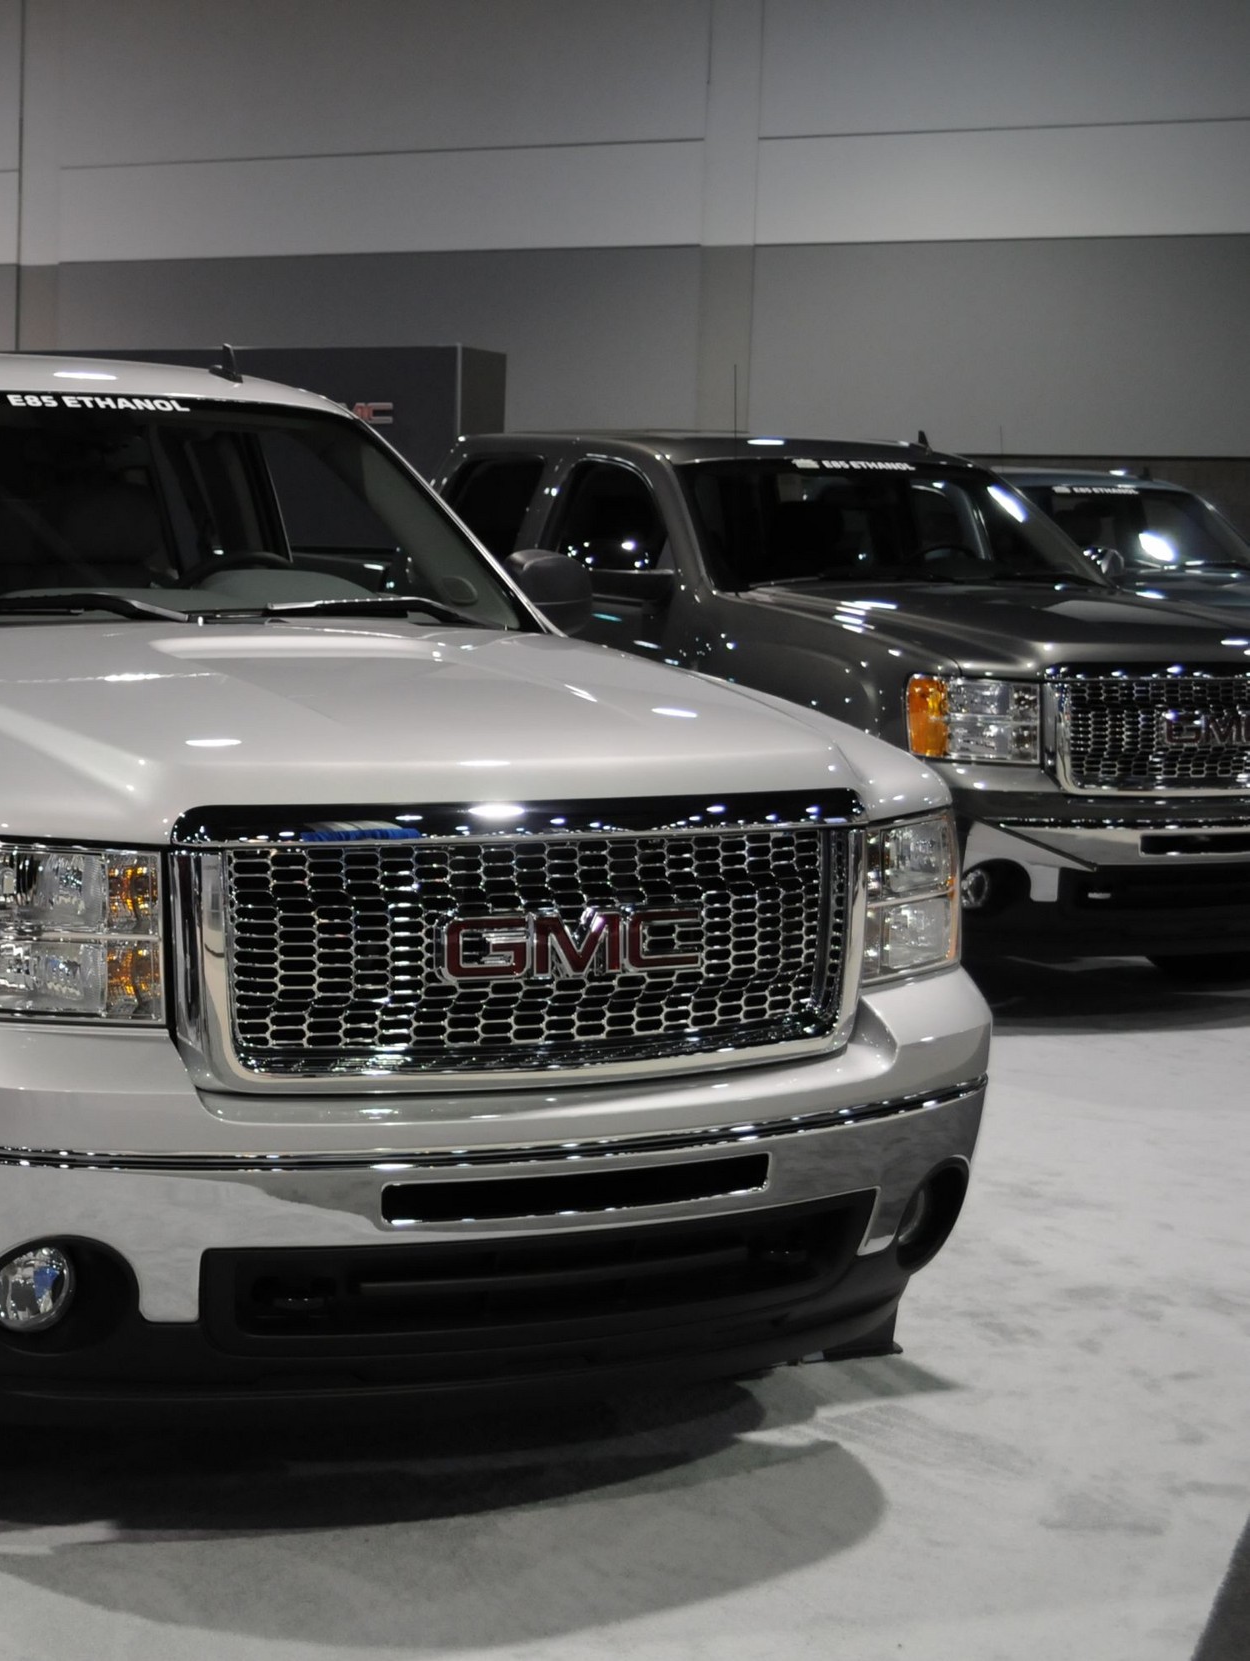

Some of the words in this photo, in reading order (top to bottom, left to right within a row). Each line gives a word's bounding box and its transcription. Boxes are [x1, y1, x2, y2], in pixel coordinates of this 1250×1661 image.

[7, 394, 58, 407] E85
[62, 395, 191, 412] ETHANOL
[1162, 711, 1250, 746] GM
[436, 904, 701, 984] GMC
